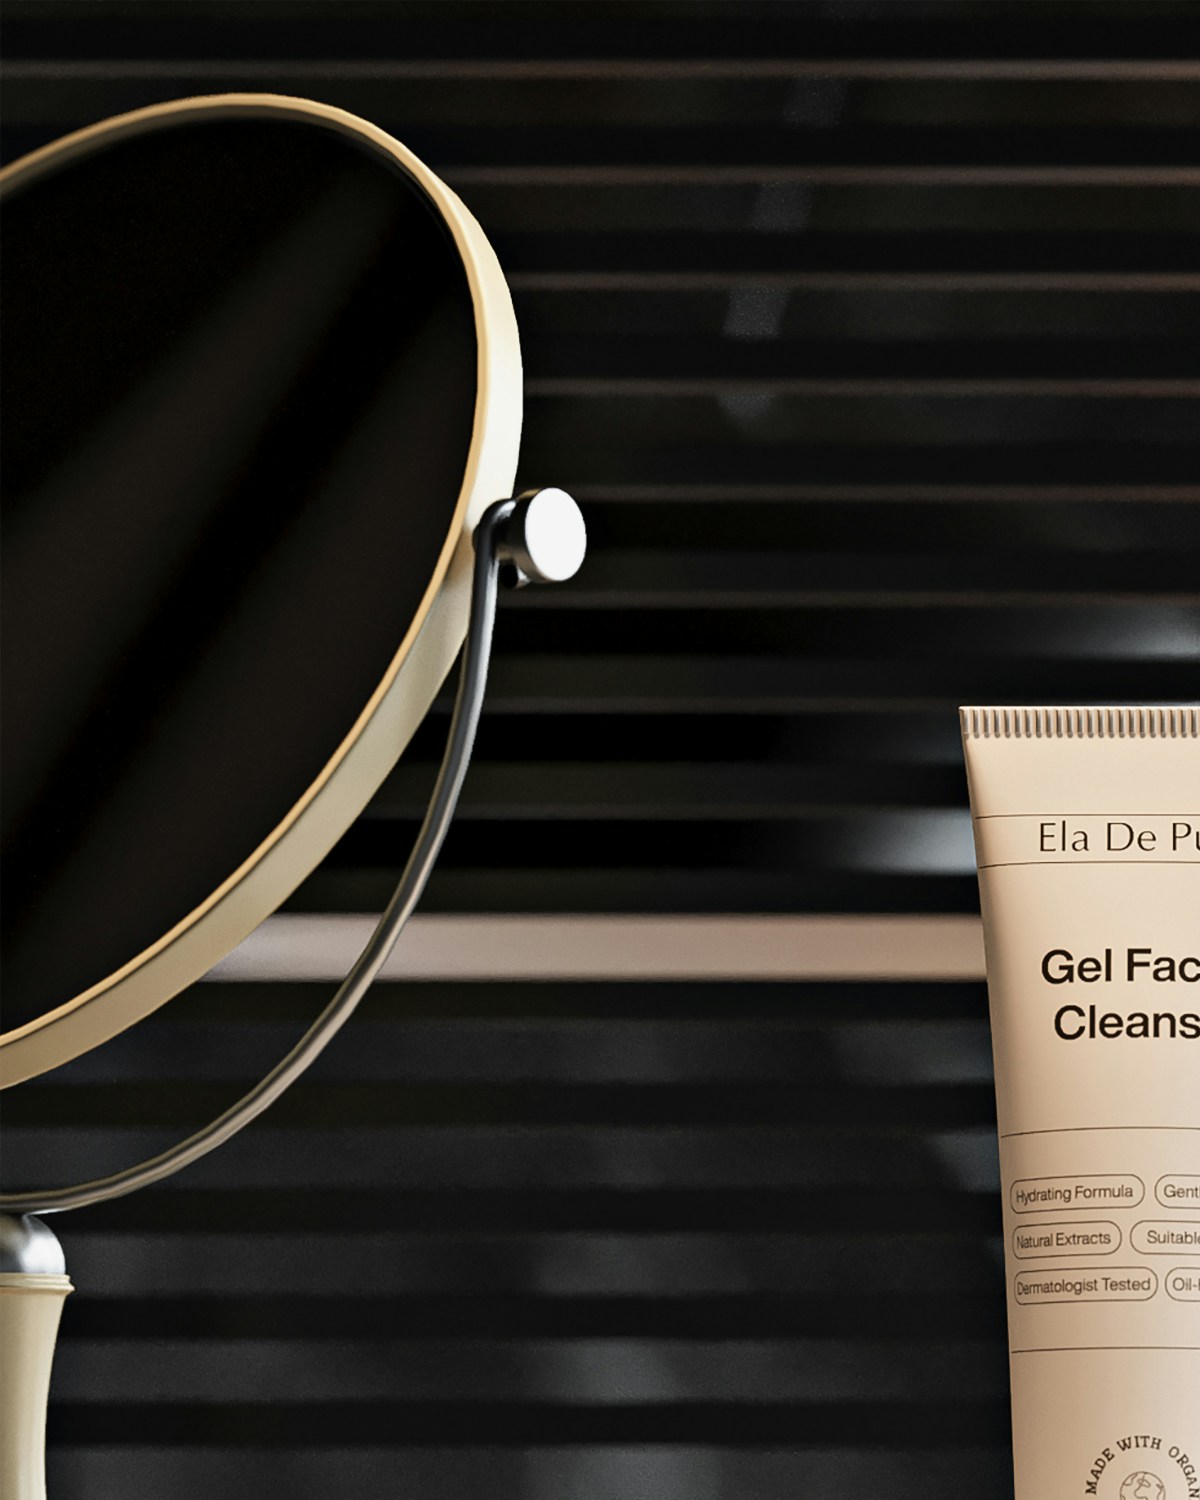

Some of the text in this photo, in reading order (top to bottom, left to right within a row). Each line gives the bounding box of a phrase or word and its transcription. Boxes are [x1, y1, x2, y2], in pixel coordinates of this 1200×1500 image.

[1039, 820, 1090, 852] Ela
[1106, 821, 1157, 852] De
[1041, 948, 1112, 984] Gel
[1016, 1184, 1133, 1206] Hydrating Formula
[1016, 1232, 1112, 1249] Natural Extracts
[1017, 1277, 1151, 1296] Dermatologist Tested
[1085, 1447, 1115, 1495] MADE
[1116, 1435, 1162, 1451] WITH
